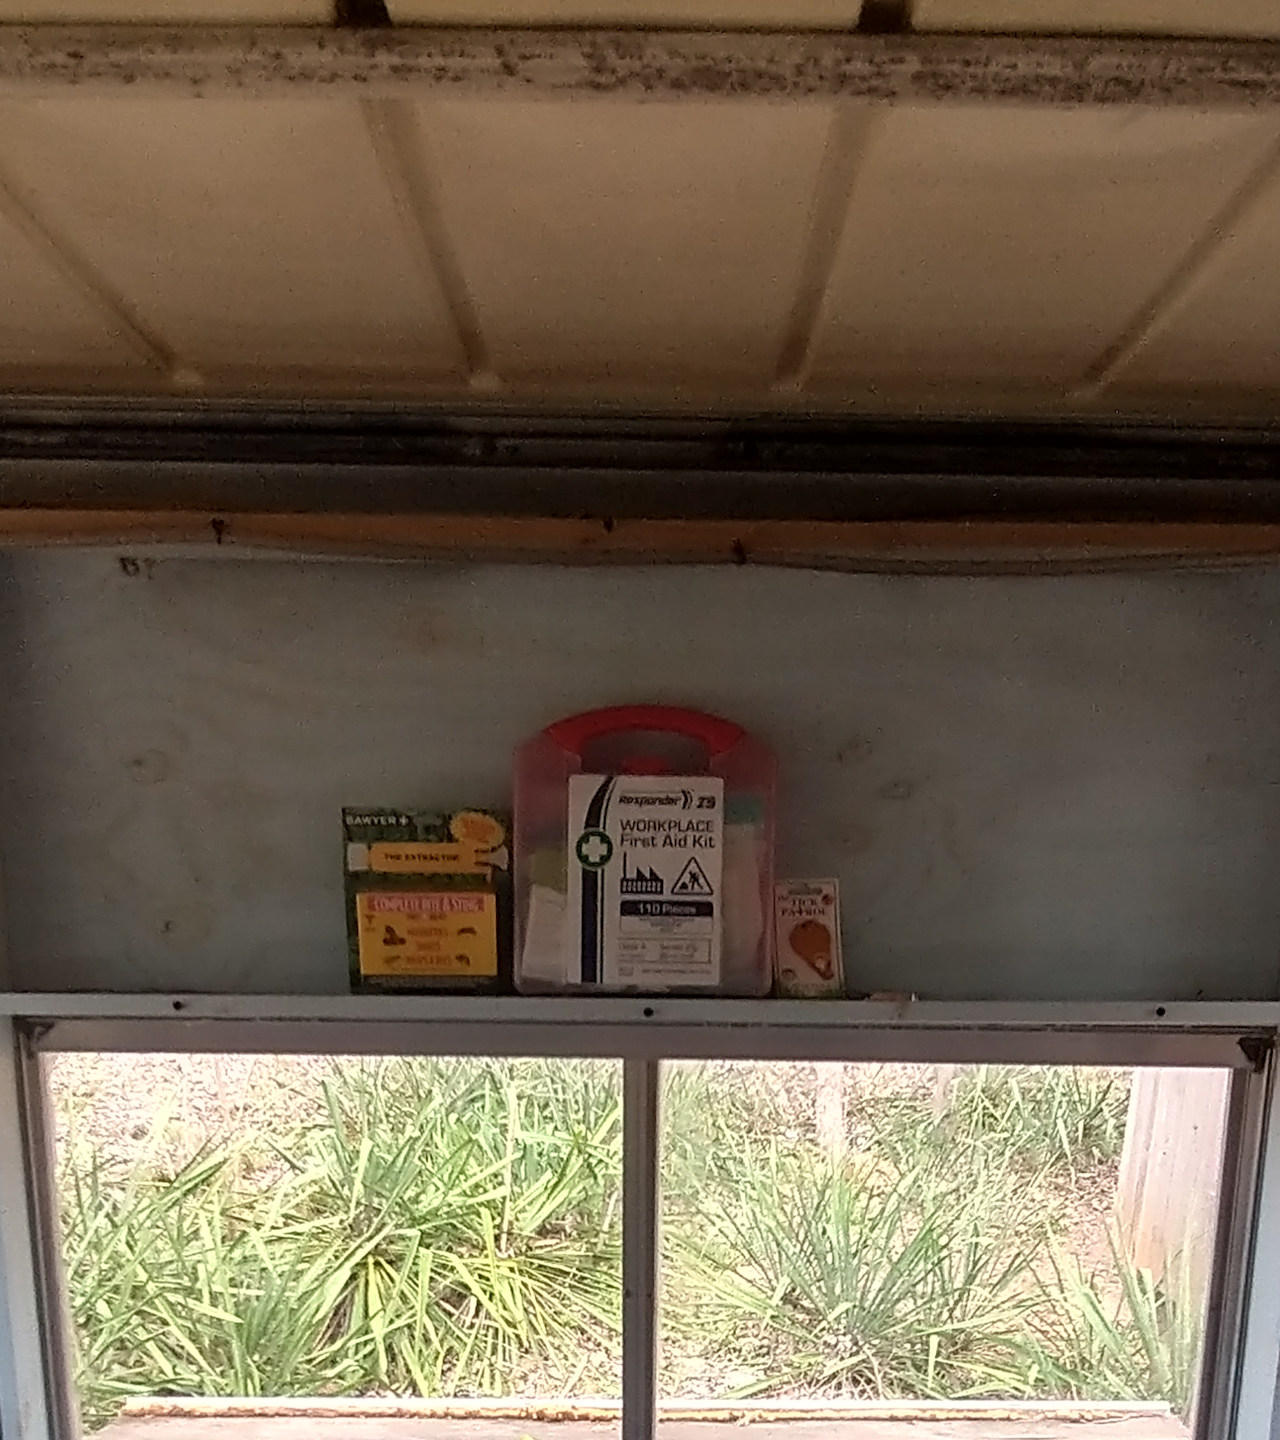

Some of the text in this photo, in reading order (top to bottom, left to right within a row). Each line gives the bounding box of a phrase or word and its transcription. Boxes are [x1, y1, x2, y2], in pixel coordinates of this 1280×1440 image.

[346, 815, 397, 826] SAWYER
[620, 819, 714, 832] WORKPLACE
[620, 834, 716, 848] First Aid Kit
[640, 902, 660, 914] 110
